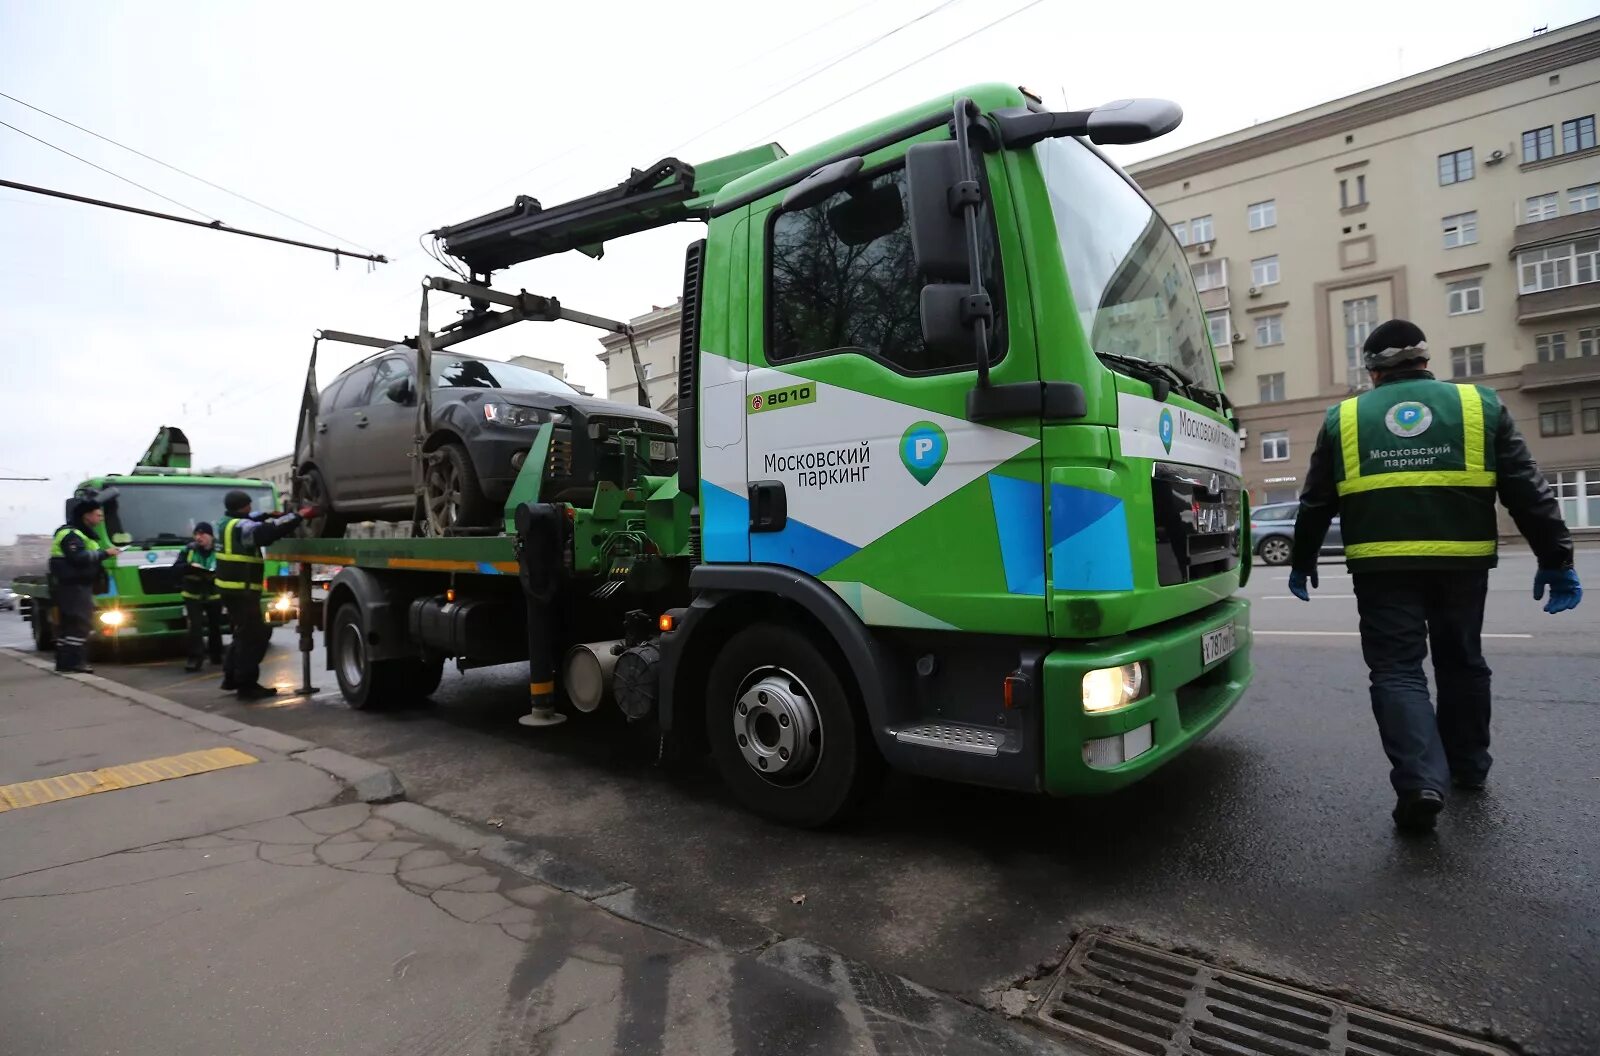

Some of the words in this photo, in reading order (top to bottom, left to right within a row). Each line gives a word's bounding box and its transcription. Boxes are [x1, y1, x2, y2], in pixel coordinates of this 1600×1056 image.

[768, 388, 810, 405] 8010
[764, 441, 870, 473] Московский
[915, 438, 933, 460] P
[1370, 443, 1451, 459] Московский
[1384, 456, 1436, 468] паркинг
[798, 466, 870, 490] паркинг
